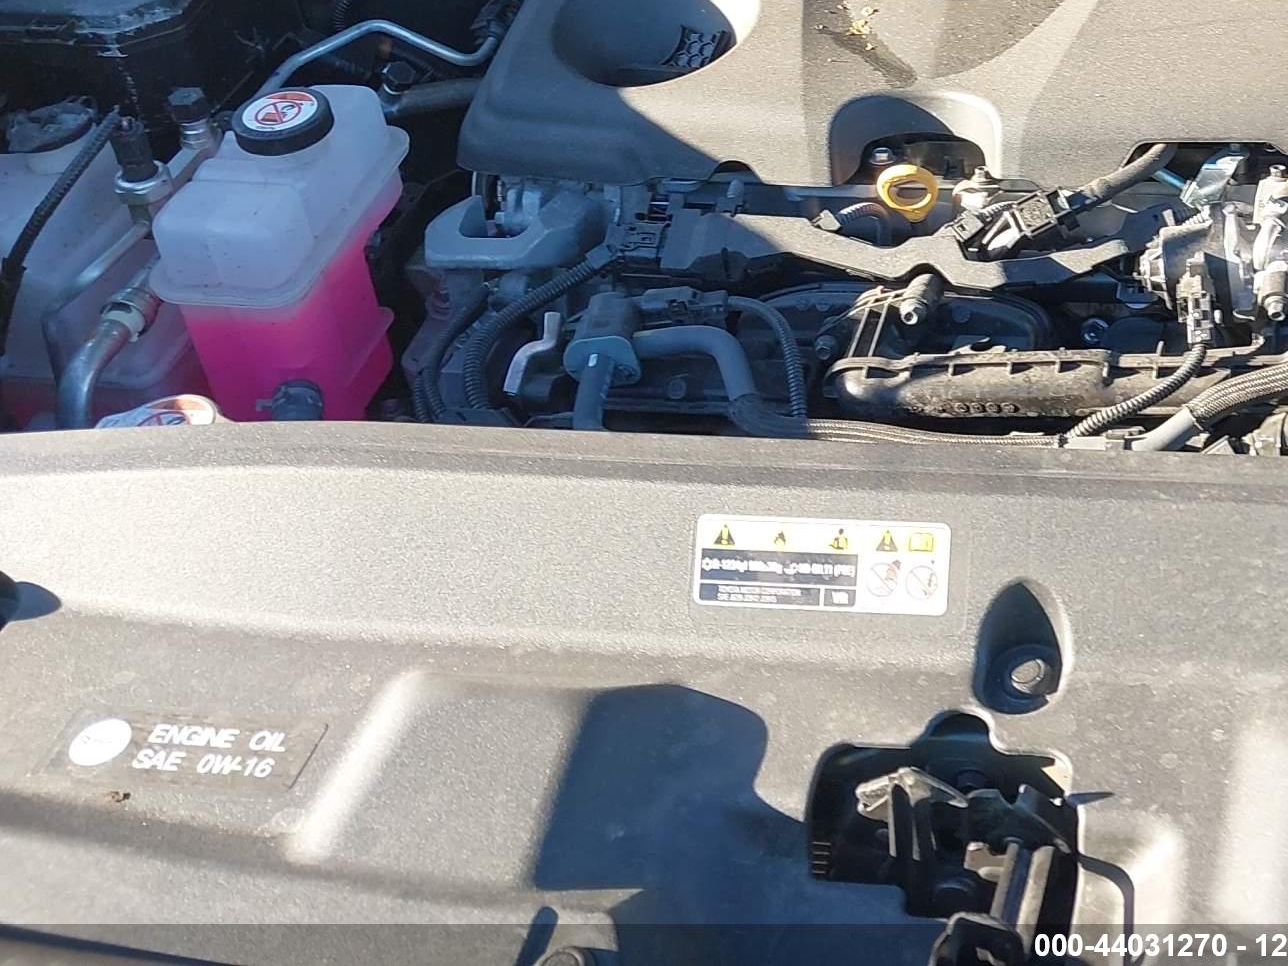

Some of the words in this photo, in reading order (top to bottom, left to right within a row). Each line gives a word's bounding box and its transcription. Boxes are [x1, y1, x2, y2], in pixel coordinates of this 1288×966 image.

[147, 723, 240, 749] ENGINE
[248, 730, 286, 753] OIL
[131, 748, 187, 771] SAE
[196, 755, 276, 778] 0W-16
